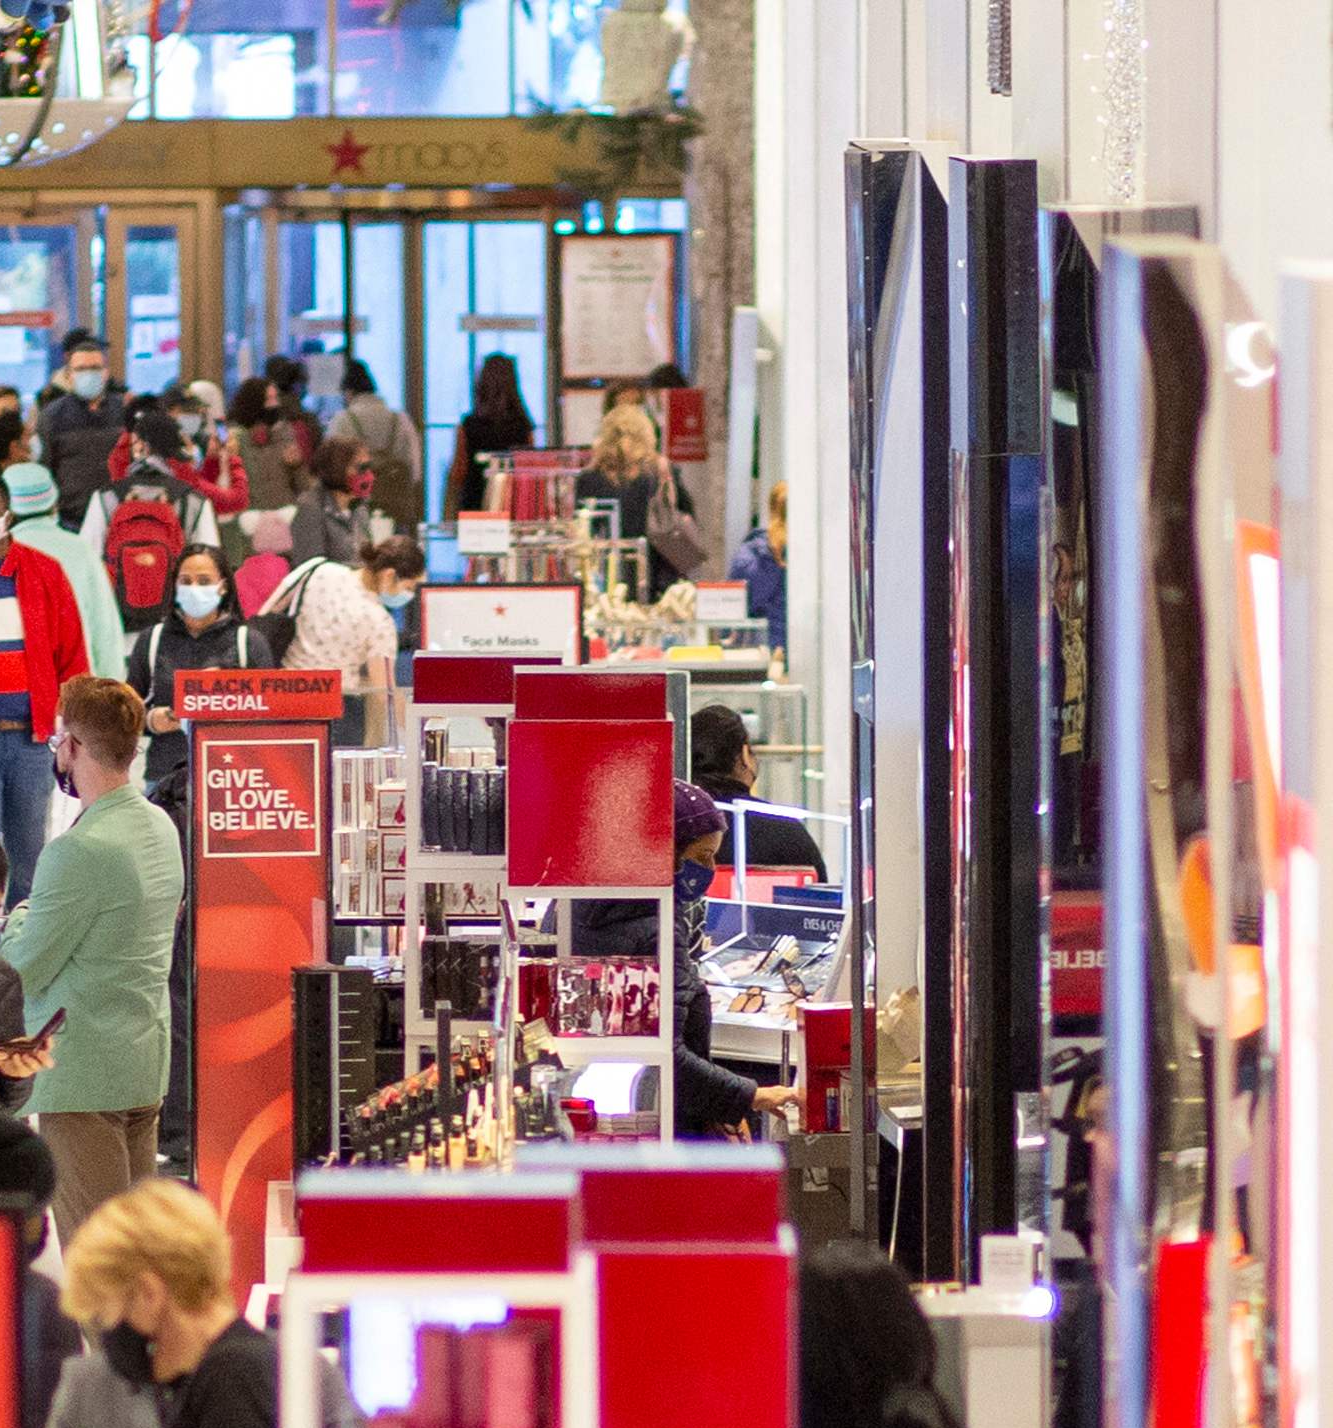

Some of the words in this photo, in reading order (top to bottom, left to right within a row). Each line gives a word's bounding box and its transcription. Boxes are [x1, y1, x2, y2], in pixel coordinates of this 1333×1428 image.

[462, 635, 493, 647] Face
[497, 635, 539, 647] Masks
[184, 678, 254, 694] BLACK
[260, 677, 333, 694] FRIDAY
[183, 694, 270, 712] SPECIAL
[207, 768, 271, 789] GIVE.
[225, 789, 296, 810] LOVE.
[209, 810, 316, 831] BELIEVE.
